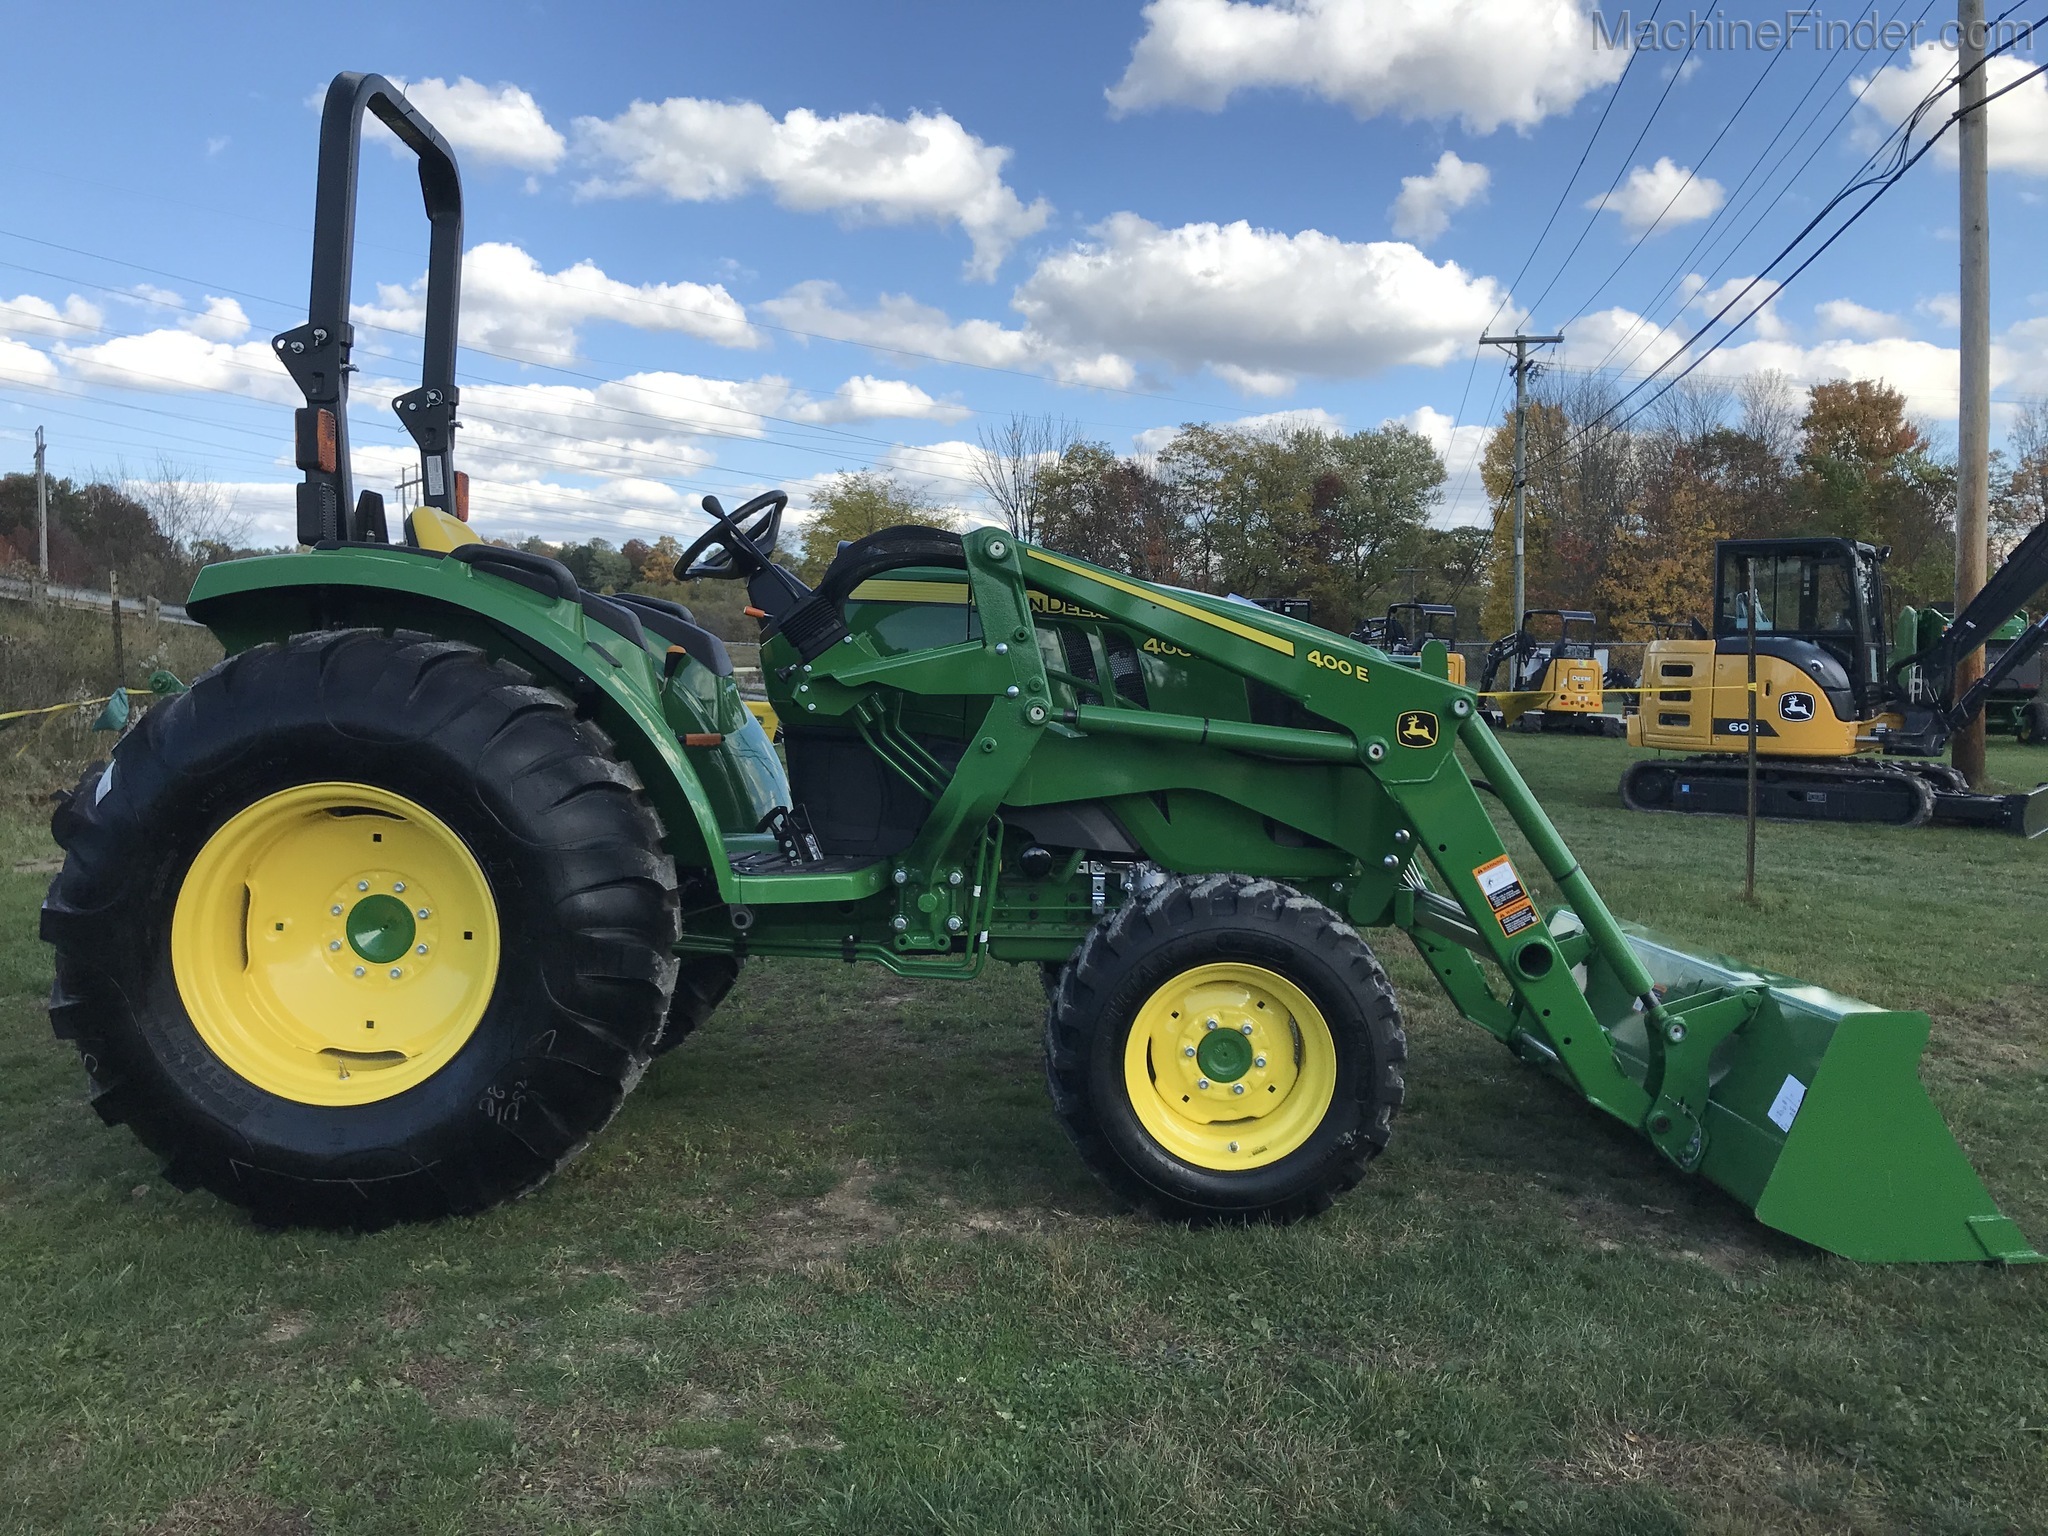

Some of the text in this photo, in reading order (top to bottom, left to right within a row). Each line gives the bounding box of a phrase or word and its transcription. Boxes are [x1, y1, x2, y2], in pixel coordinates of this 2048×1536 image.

[1307, 649, 1369, 683] 400 E
[1728, 722, 1760, 733] 60
